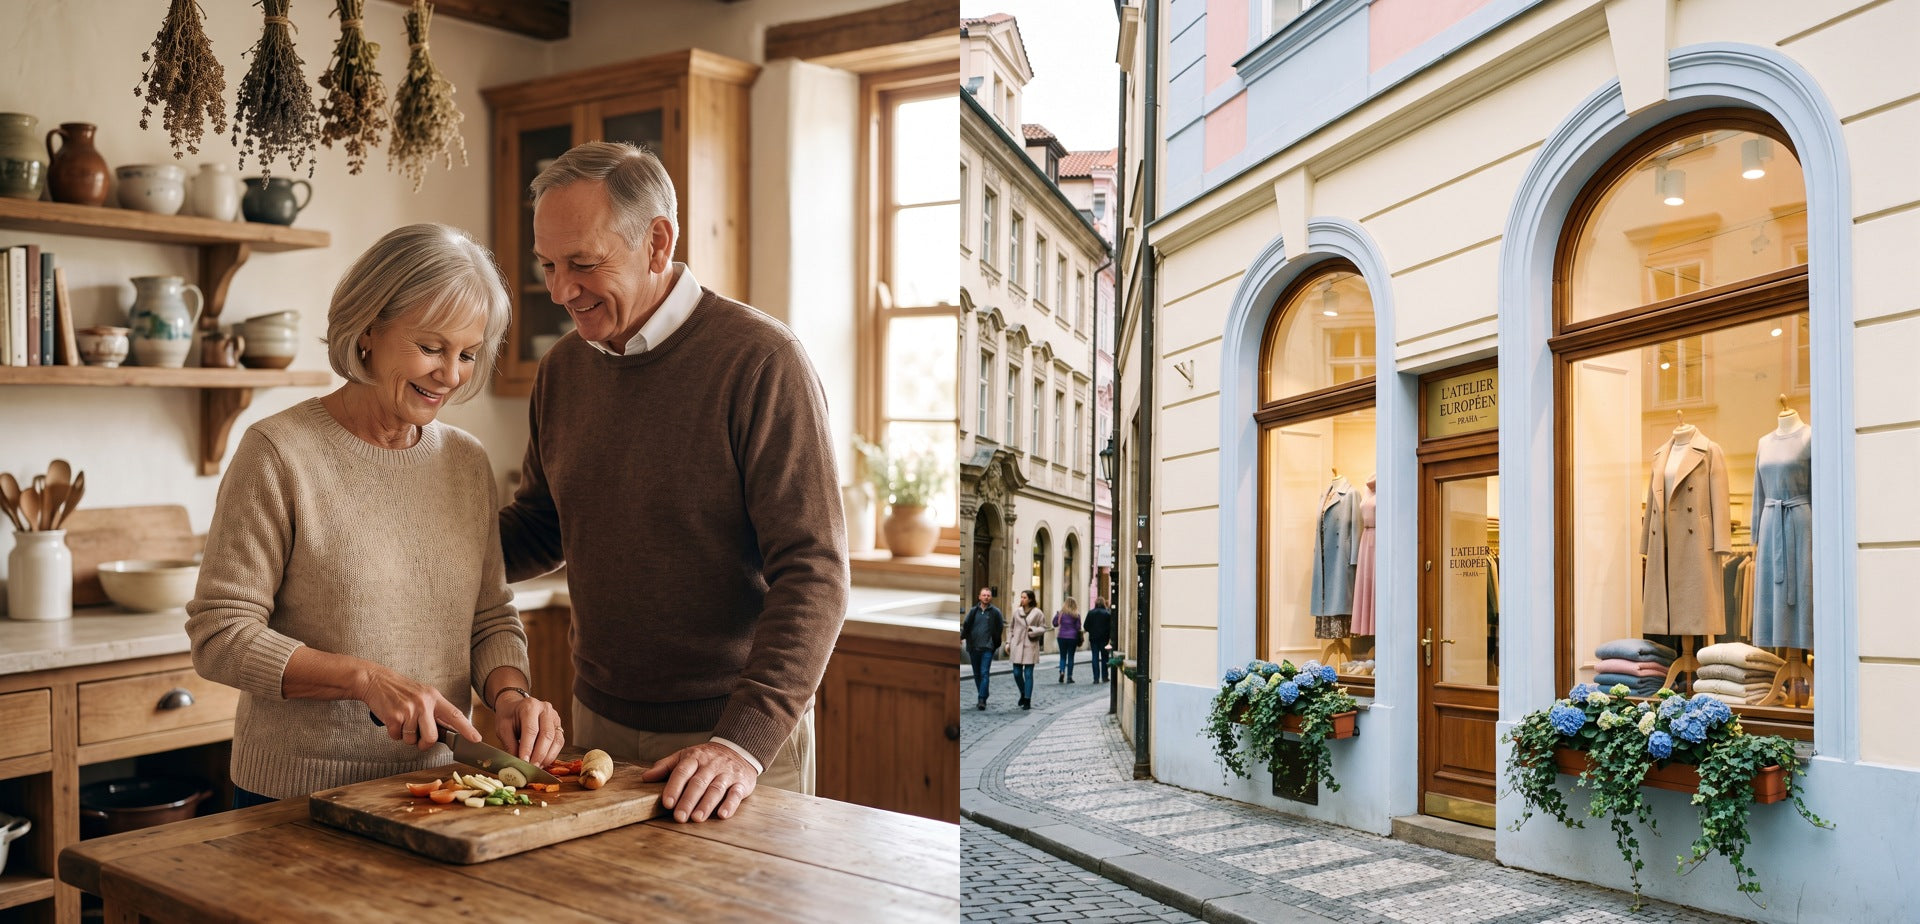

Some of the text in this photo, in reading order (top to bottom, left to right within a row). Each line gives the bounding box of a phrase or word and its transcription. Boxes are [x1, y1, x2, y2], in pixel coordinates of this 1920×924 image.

[1441, 378, 1494, 400] L'ATELIER
[1440, 394, 1496, 416] EUROPÉEN
[1457, 415, 1478, 425] PRAHA
[1451, 546, 1490, 557] L'ATELIER
